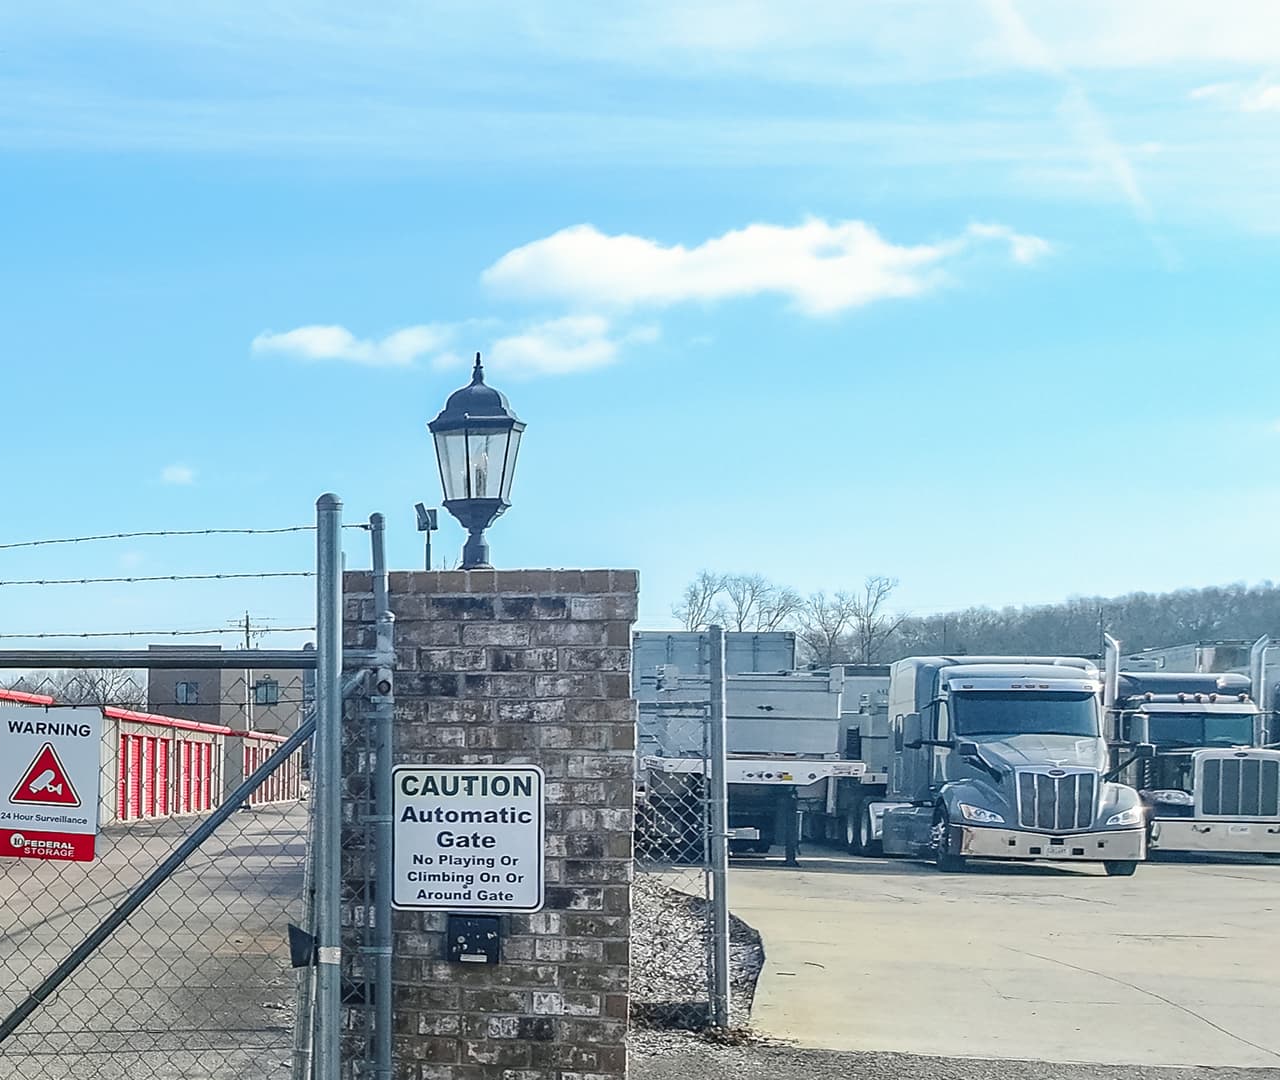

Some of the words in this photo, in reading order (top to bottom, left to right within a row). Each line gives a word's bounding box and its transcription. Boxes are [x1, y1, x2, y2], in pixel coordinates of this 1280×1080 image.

[8, 720, 91, 737] WARNING
[400, 775, 533, 797] CAUTION
[0, 811, 11, 820] 24
[13, 812, 34, 822] Hour
[36, 813, 88, 825] Surveillance
[400, 806, 533, 824] Automatic
[24, 839, 75, 850] FEDERAL
[436, 830, 497, 849] Gate
[24, 847, 74, 858] STORAGE
[412, 854, 433, 866] No
[438, 854, 495, 868] Playing
[500, 855, 519, 867] Or
[407, 871, 474, 885] Climbing
[479, 872, 500, 883] On
[506, 872, 524, 884] Or
[416, 889, 472, 901] Around
[477, 890, 514, 901] Gate
